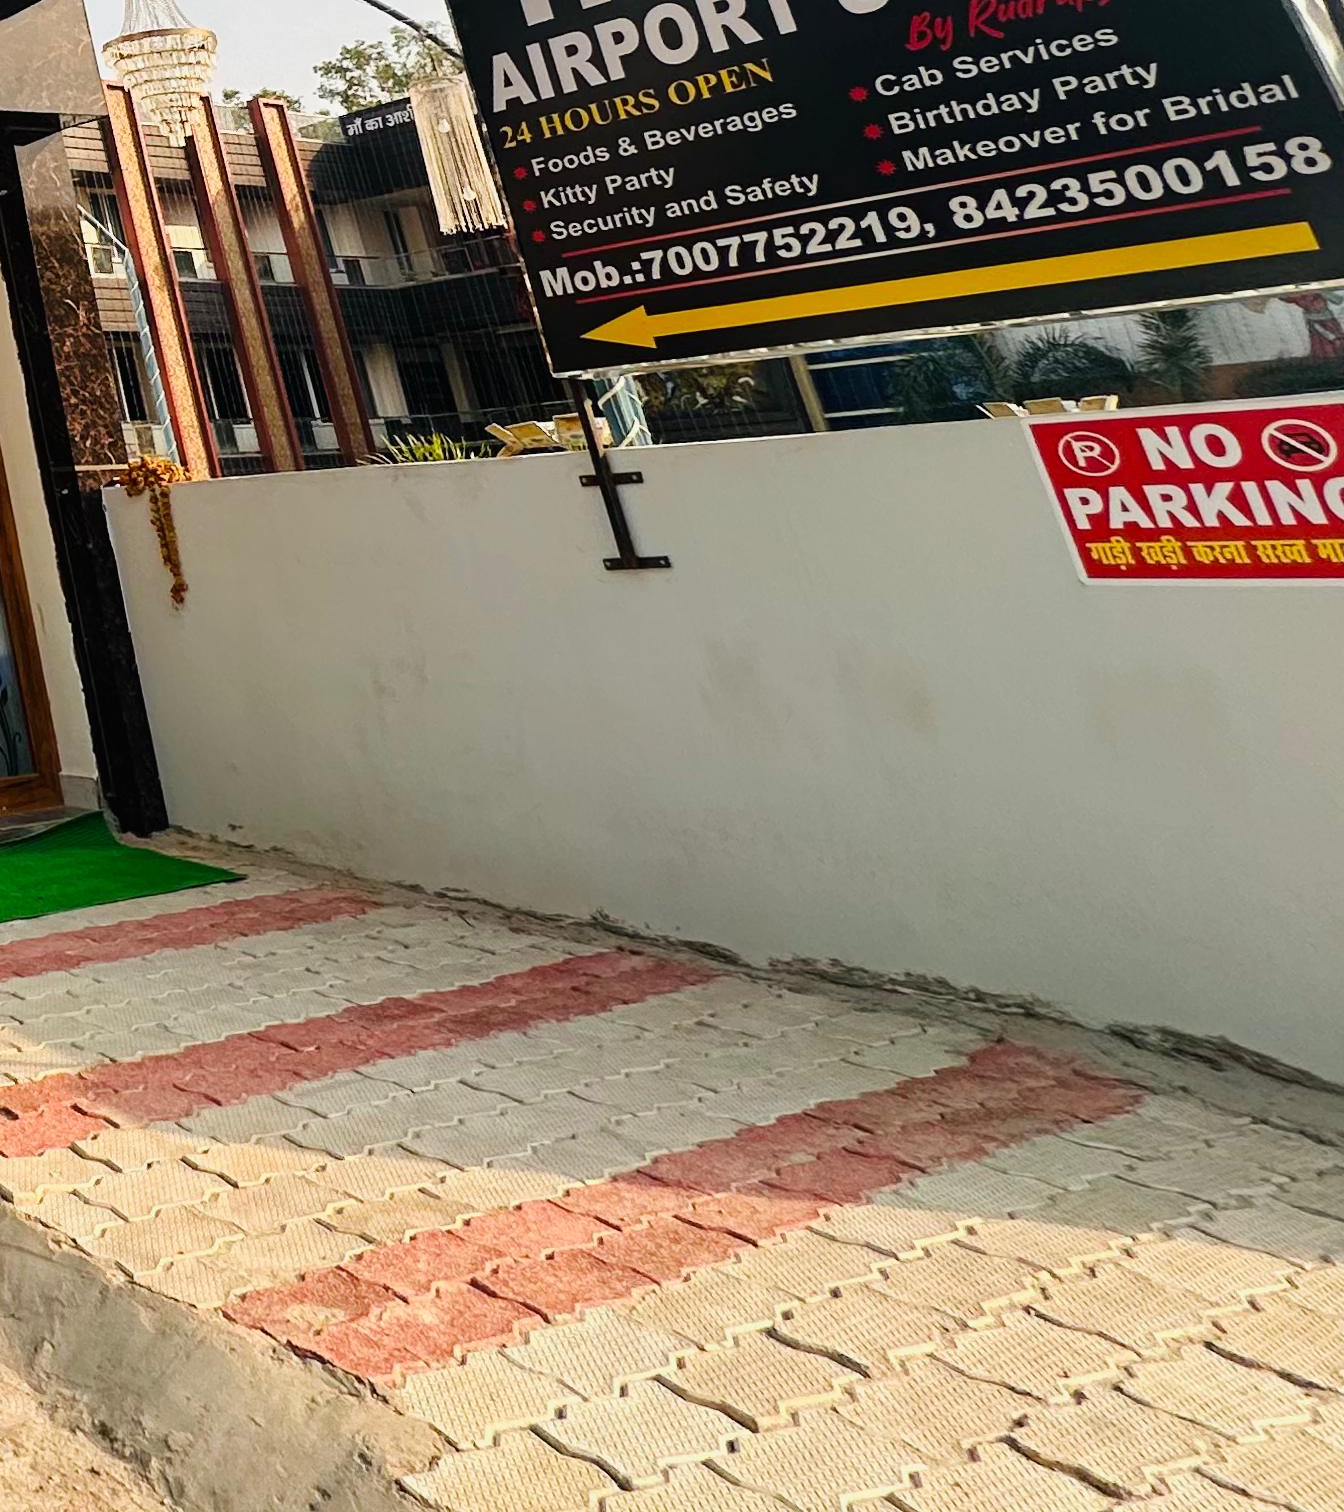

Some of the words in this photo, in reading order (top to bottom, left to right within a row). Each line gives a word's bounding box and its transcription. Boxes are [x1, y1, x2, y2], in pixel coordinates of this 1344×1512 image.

[874, 66, 944, 97] Cab
[954, 28, 1120, 80] Services
[905, 10, 953, 52] By
[499, 122, 532, 149] 24
[539, 88, 660, 141] HOURS
[668, 58, 774, 107] OPEN
[888, 88, 1041, 136] Birthday
[1051, 61, 1160, 101] Party
[902, 118, 1082, 173] Makeover
[1092, 105, 1152, 137] for
[1162, 74, 1300, 123] Bridal
[530, 141, 610, 177] Foods
[617, 136, 639, 157] &
[643, 102, 798, 152] Beverages
[540, 178, 598, 210] Kitty
[605, 164, 676, 196] Party
[549, 201, 656, 242] Security
[665, 187, 718, 219] and
[725, 171, 820, 208] Safety
[948, 135, 1332, 230] 8423500158
[1135, 423, 1243, 471] NO
[1085, 536, 1135, 571] गाड़ी
[1136, 536, 1187, 571] खड़ी
[1186, 540, 1252, 565] करना
